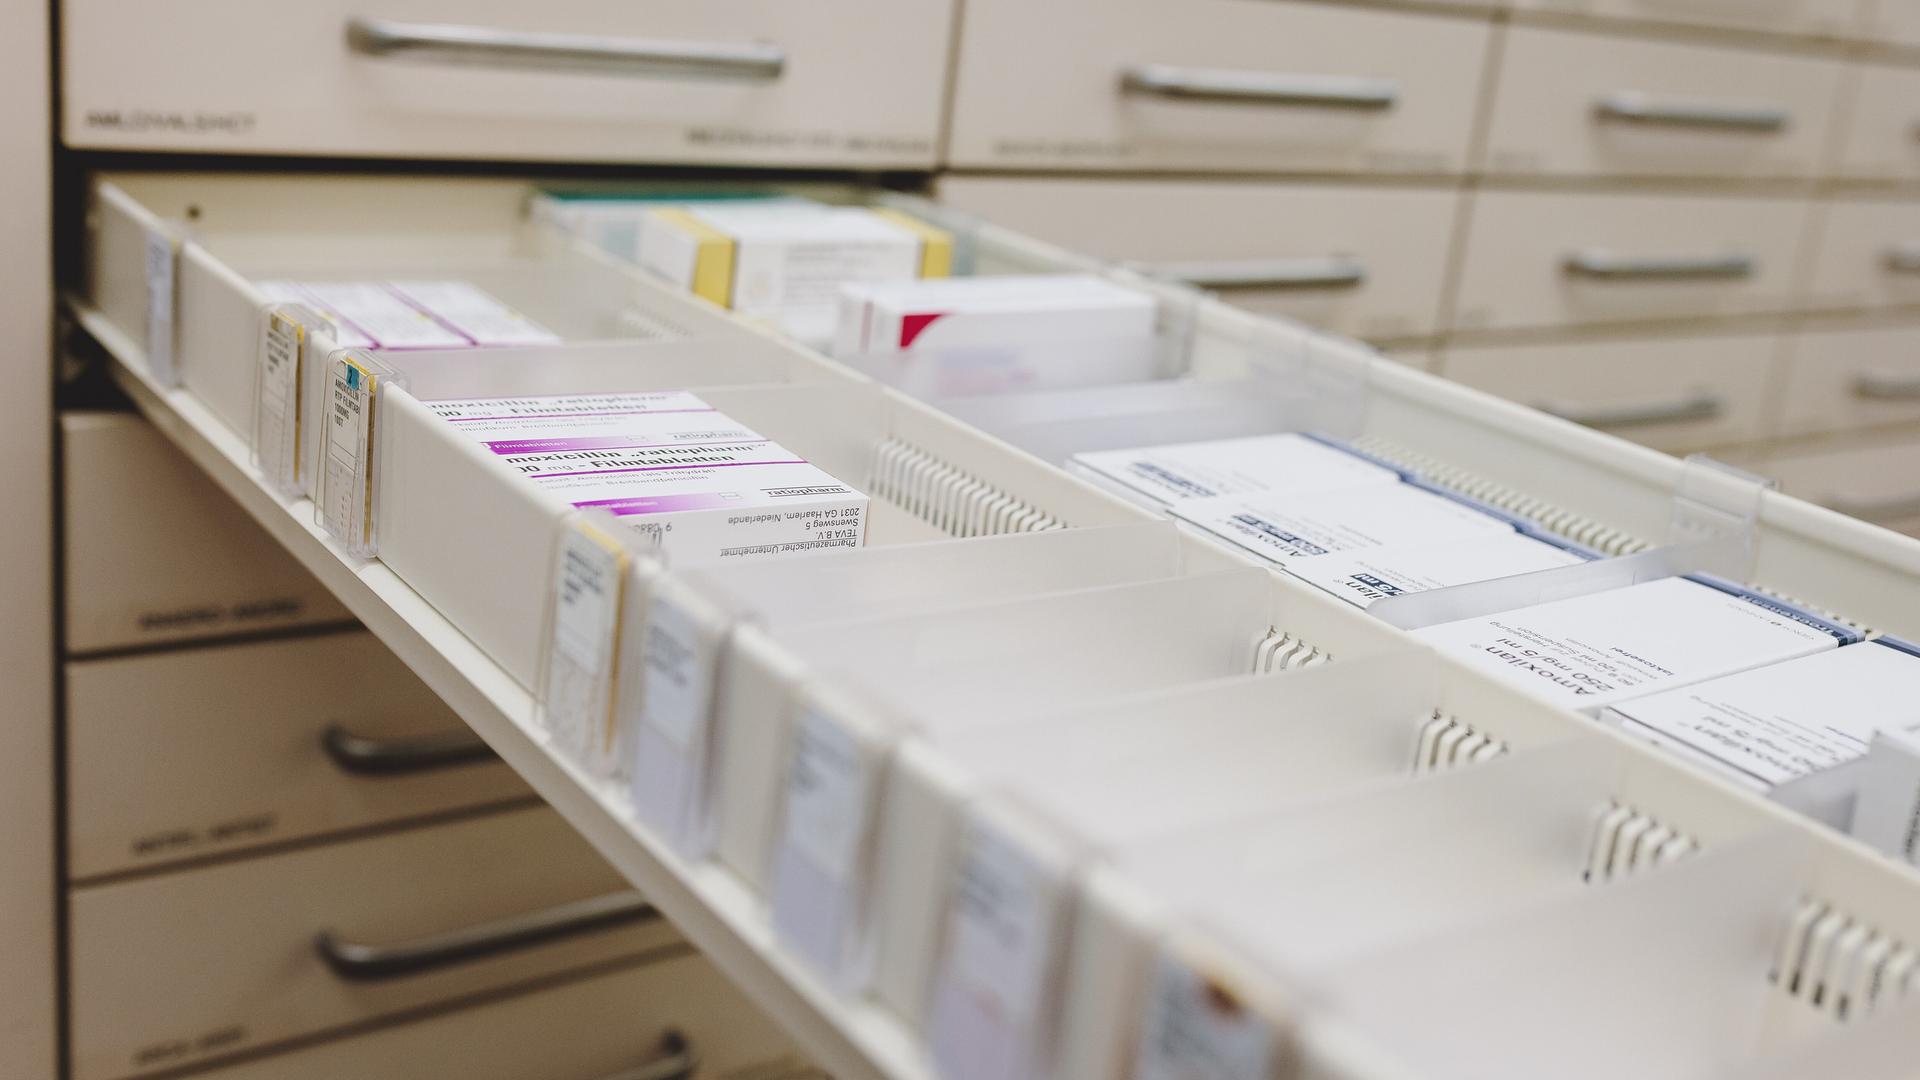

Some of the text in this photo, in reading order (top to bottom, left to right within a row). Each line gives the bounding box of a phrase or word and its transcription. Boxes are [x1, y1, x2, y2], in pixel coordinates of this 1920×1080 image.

[494, 441, 568, 450] Filmtabletten
[590, 454, 735, 468] Filmtabletten
[767, 486, 846, 496] ratiopharm
[728, 506, 860, 524] 2031 GA Haarlem, Niederlande
[805, 518, 859, 530] Swensweg 5
[815, 529, 857, 539] TEVA B.V.
[719, 538, 856, 557] Pharmazeutischer Unternehmer
[1495, 637, 1616, 692] 250 mg/5 ml
[1610, 647, 1675, 677] laktosefrei
[1485, 645, 1596, 697] Amoxilan
